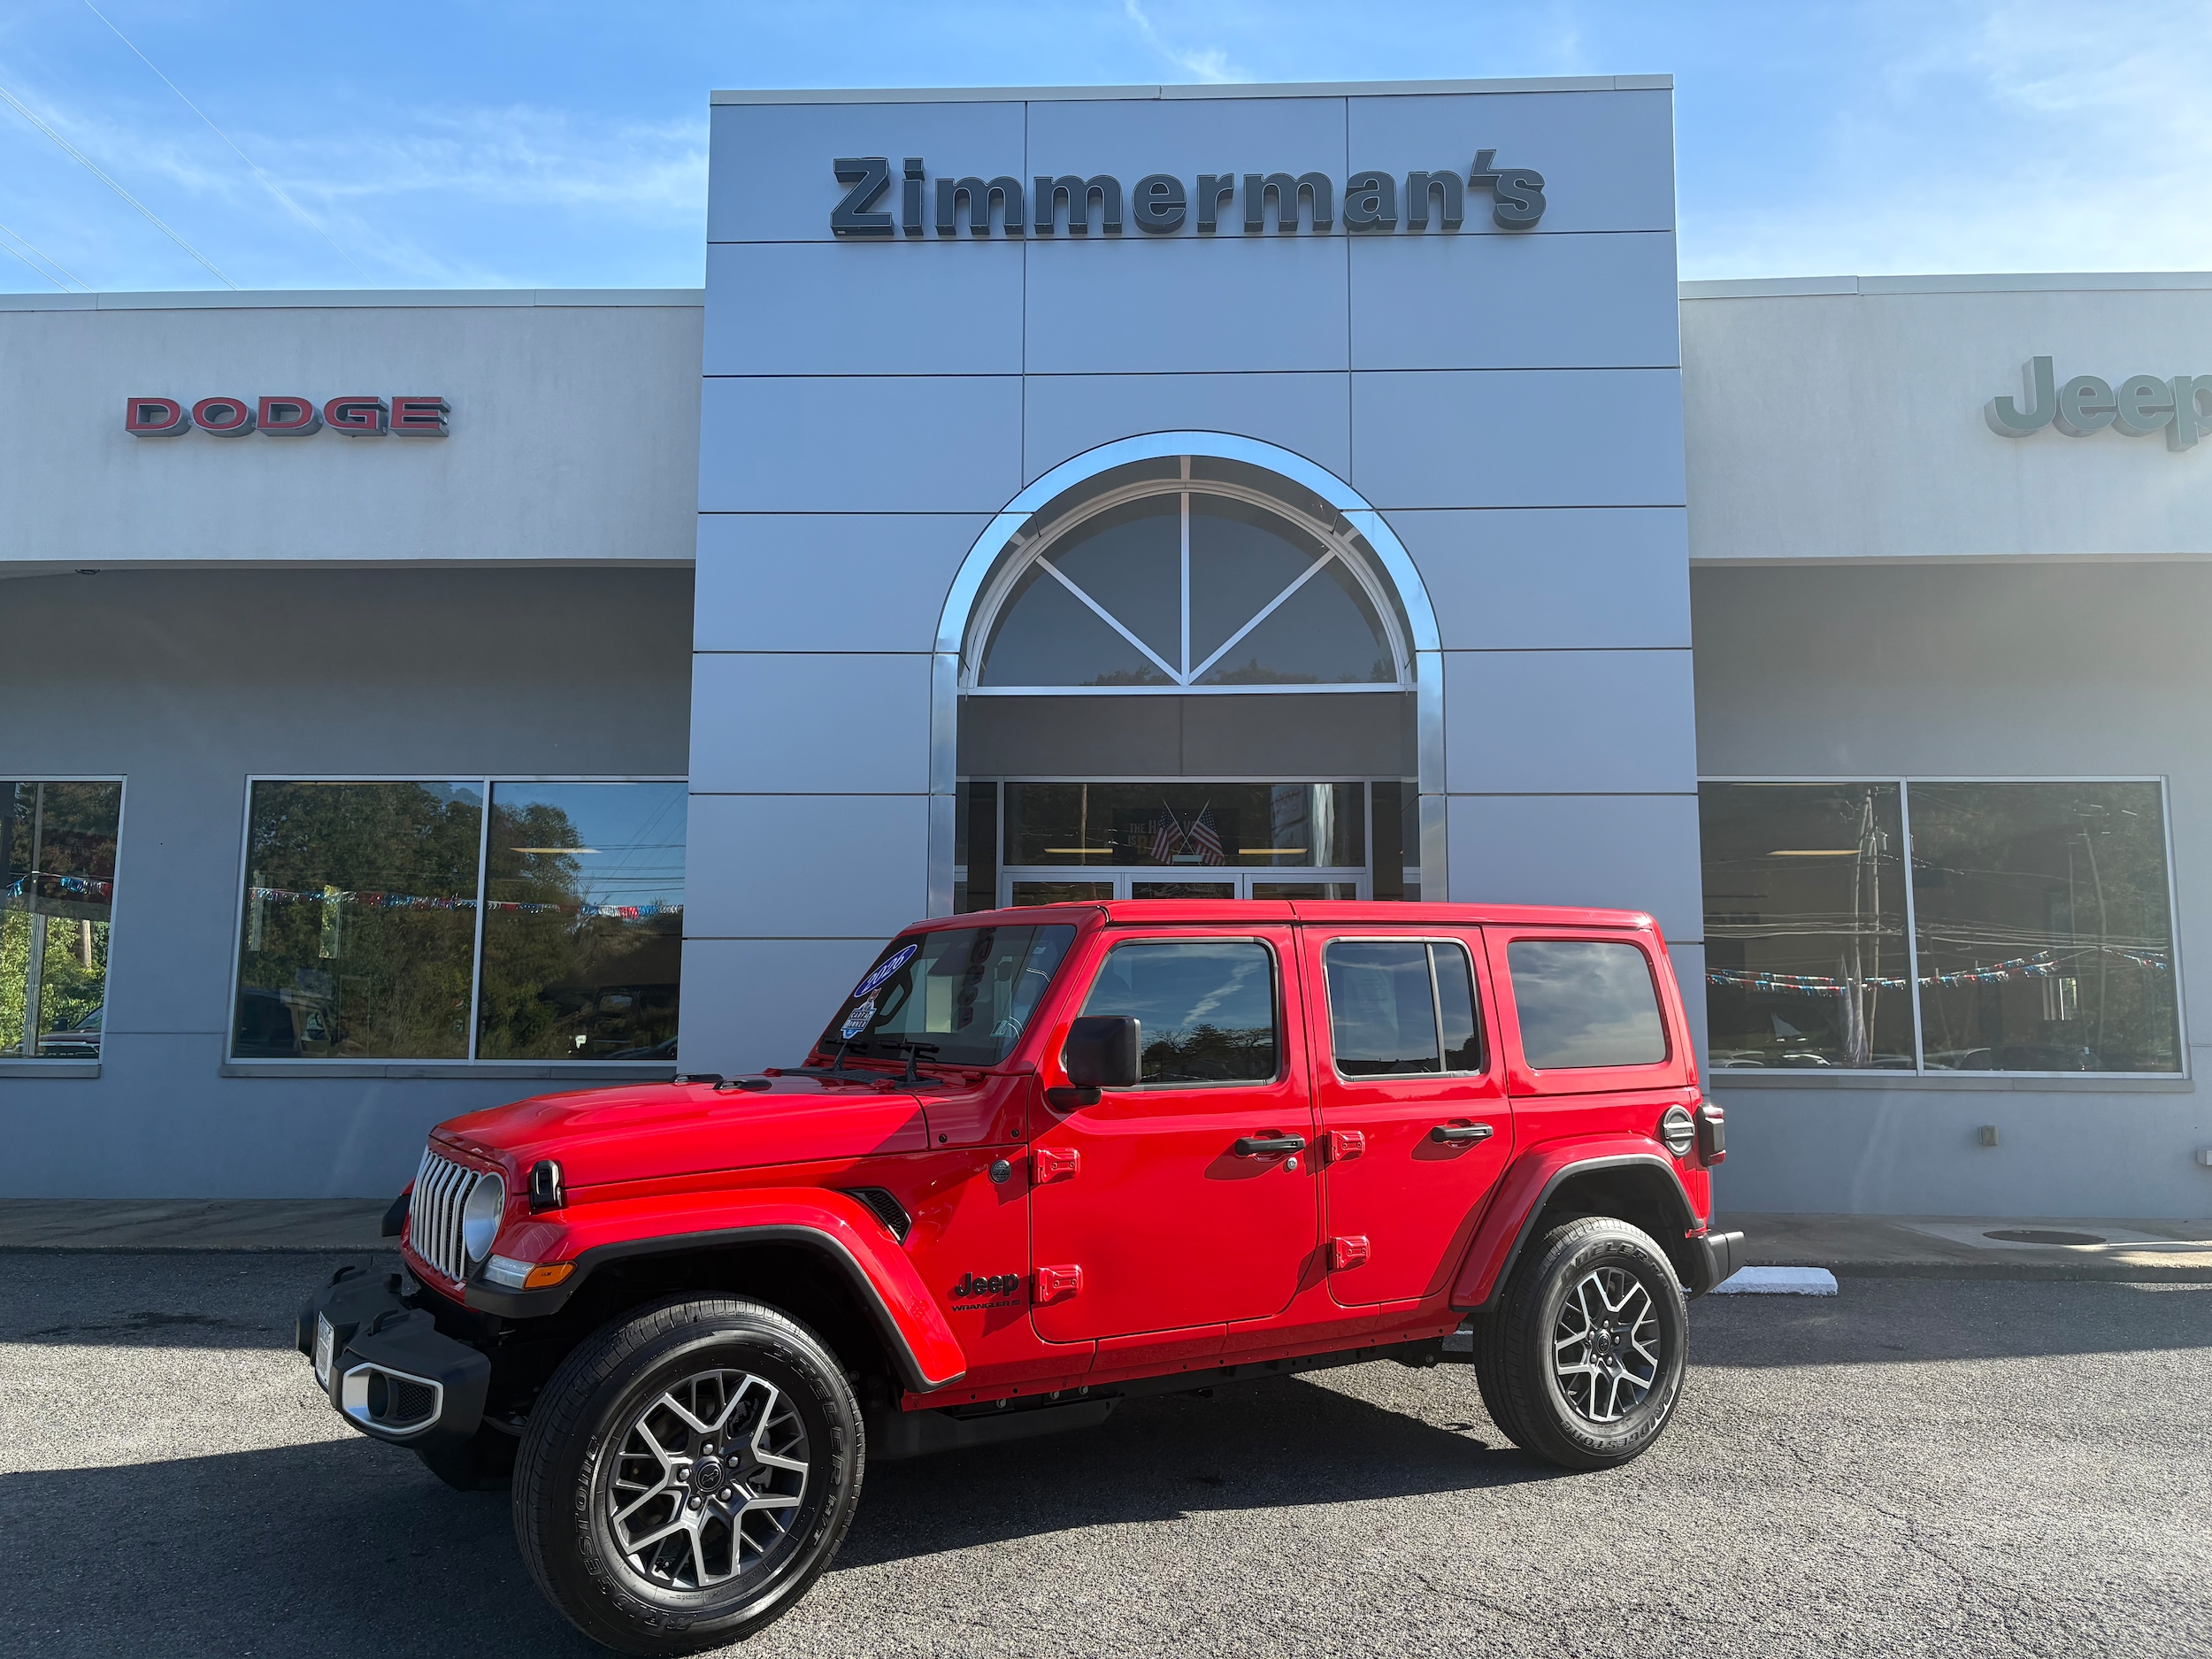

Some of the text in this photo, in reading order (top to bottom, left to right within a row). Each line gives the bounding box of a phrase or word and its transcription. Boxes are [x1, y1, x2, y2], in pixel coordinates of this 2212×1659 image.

[829, 149, 1547, 236] Zimmerman's
[125, 396, 452, 437] DODGE
[1984, 356, 2212, 452] Jeep
[1129, 822, 1146, 833] THE
[860, 947, 910, 995] 2026
[951, 1301, 1010, 1312] WRANGLER
[954, 1271, 1020, 1297] Jeep
[1561, 1383, 1673, 1451] BRIDGESTONE
[574, 1434, 698, 1632] BRIDGESTONE
